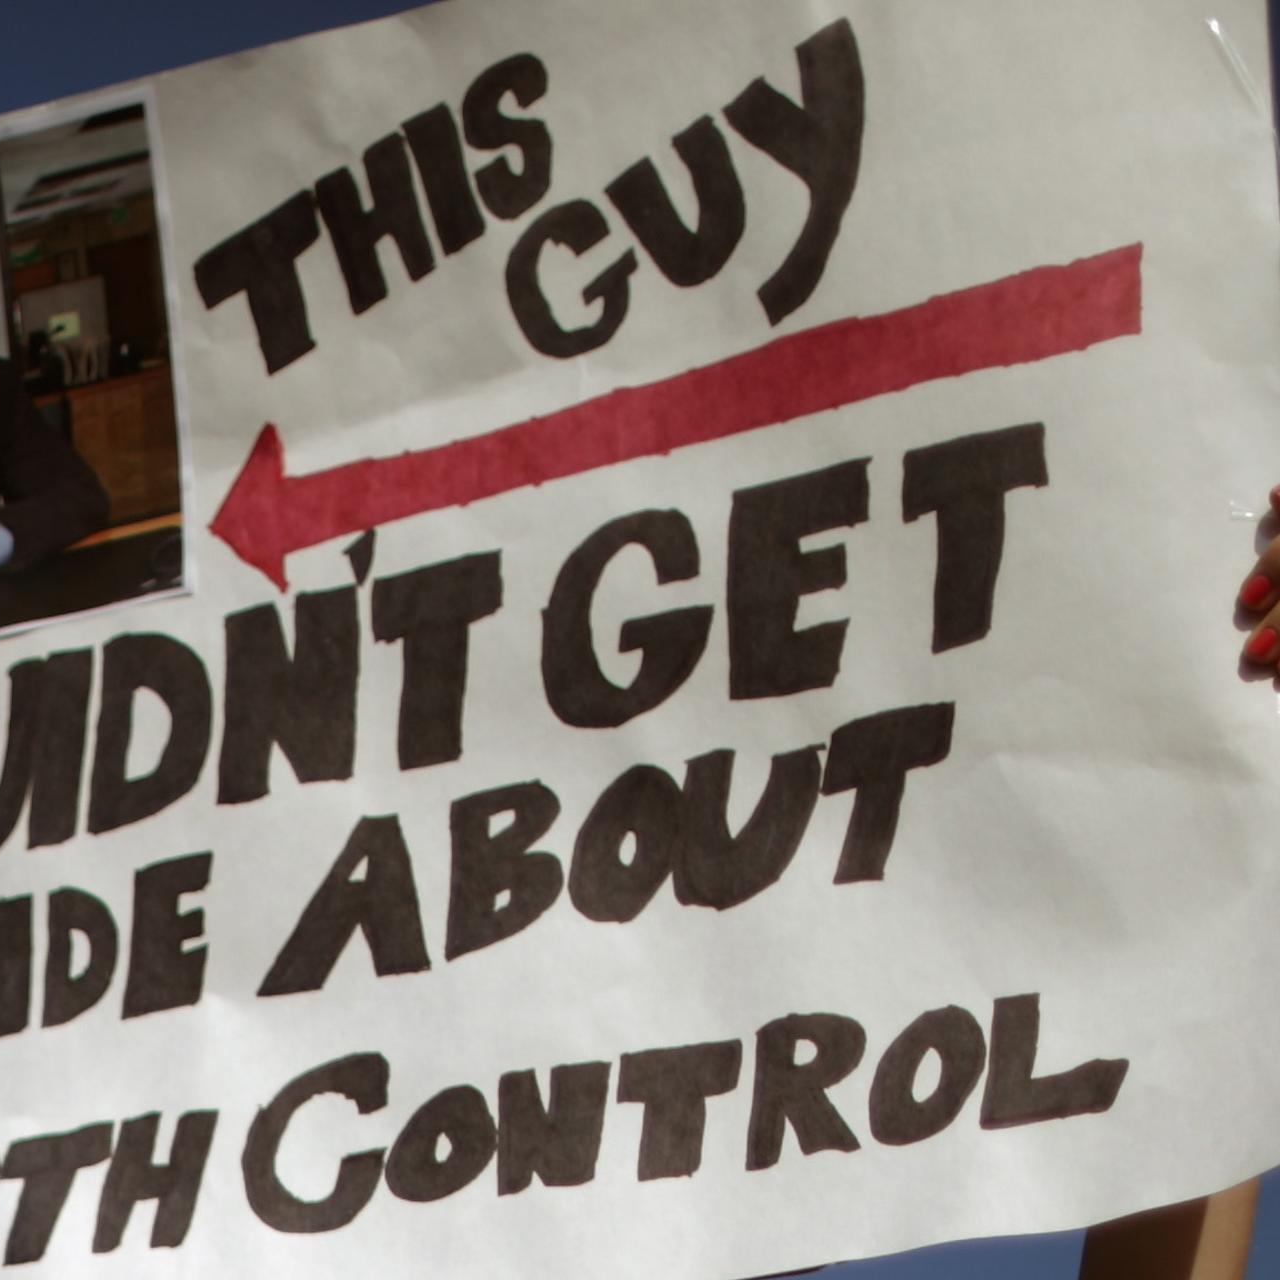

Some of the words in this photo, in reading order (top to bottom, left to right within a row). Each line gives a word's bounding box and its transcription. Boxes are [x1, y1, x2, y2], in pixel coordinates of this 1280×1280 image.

[192, 52, 554, 376] THIS
[503, 18, 867, 358] GUY
[541, 422, 1046, 729] GET
[258, 702, 956, 998] ABOUT
[241, 993, 1128, 1234] CONTROL
